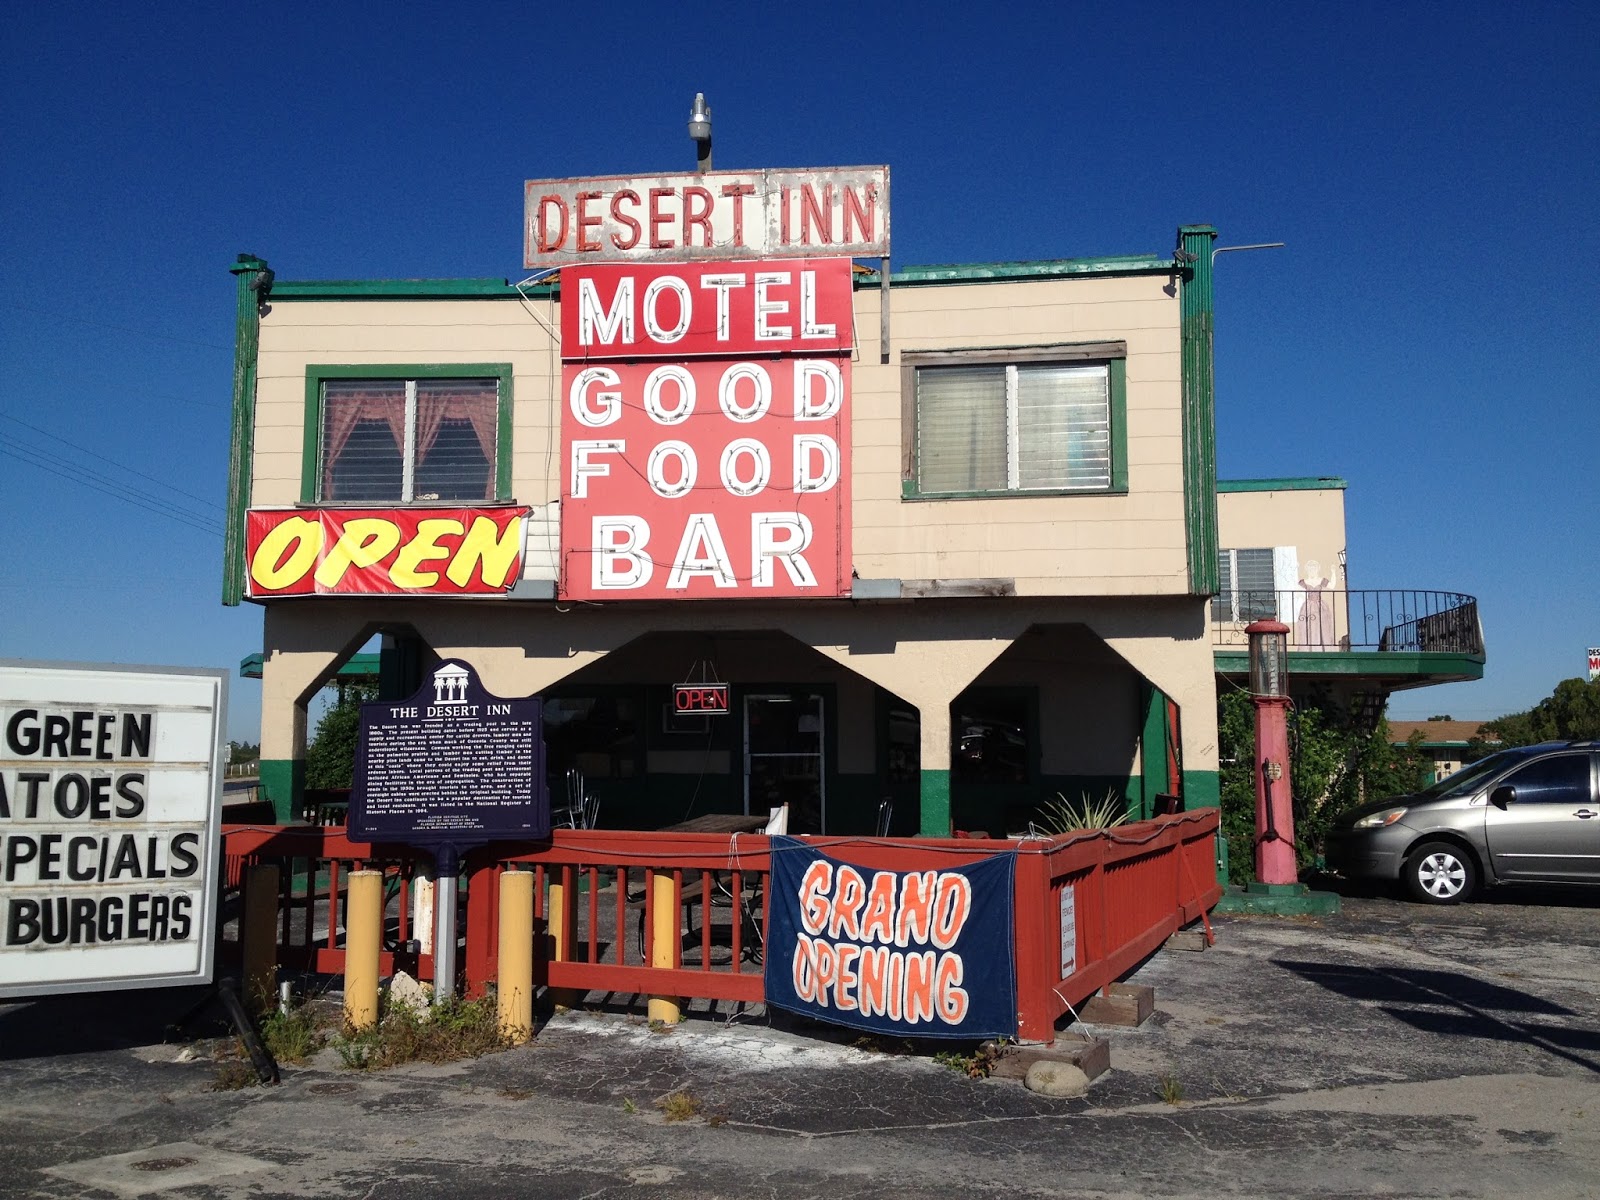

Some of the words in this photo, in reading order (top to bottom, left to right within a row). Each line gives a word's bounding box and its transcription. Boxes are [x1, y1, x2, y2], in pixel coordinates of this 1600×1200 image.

[537, 183, 755, 253] DESERT
[780, 182, 875, 246] INN
[578, 271, 837, 346] MOTEL
[569, 360, 844, 427] GOOD
[570, 434, 840, 498] FOOD
[251, 515, 522, 590] OPEN
[591, 511, 819, 590] BAR
[390, 707, 418, 719] THE
[427, 705, 479, 718] DESERT
[487, 704, 511, 715] INN
[675, 689, 727, 710] OPEN
[6, 708, 152, 760] GREEN
[0, 832, 199, 883] PECIALS
[6, 894, 192, 946] BURGERS
[798, 859, 972, 950] GRAND
[792, 932, 970, 1026] OPENING
